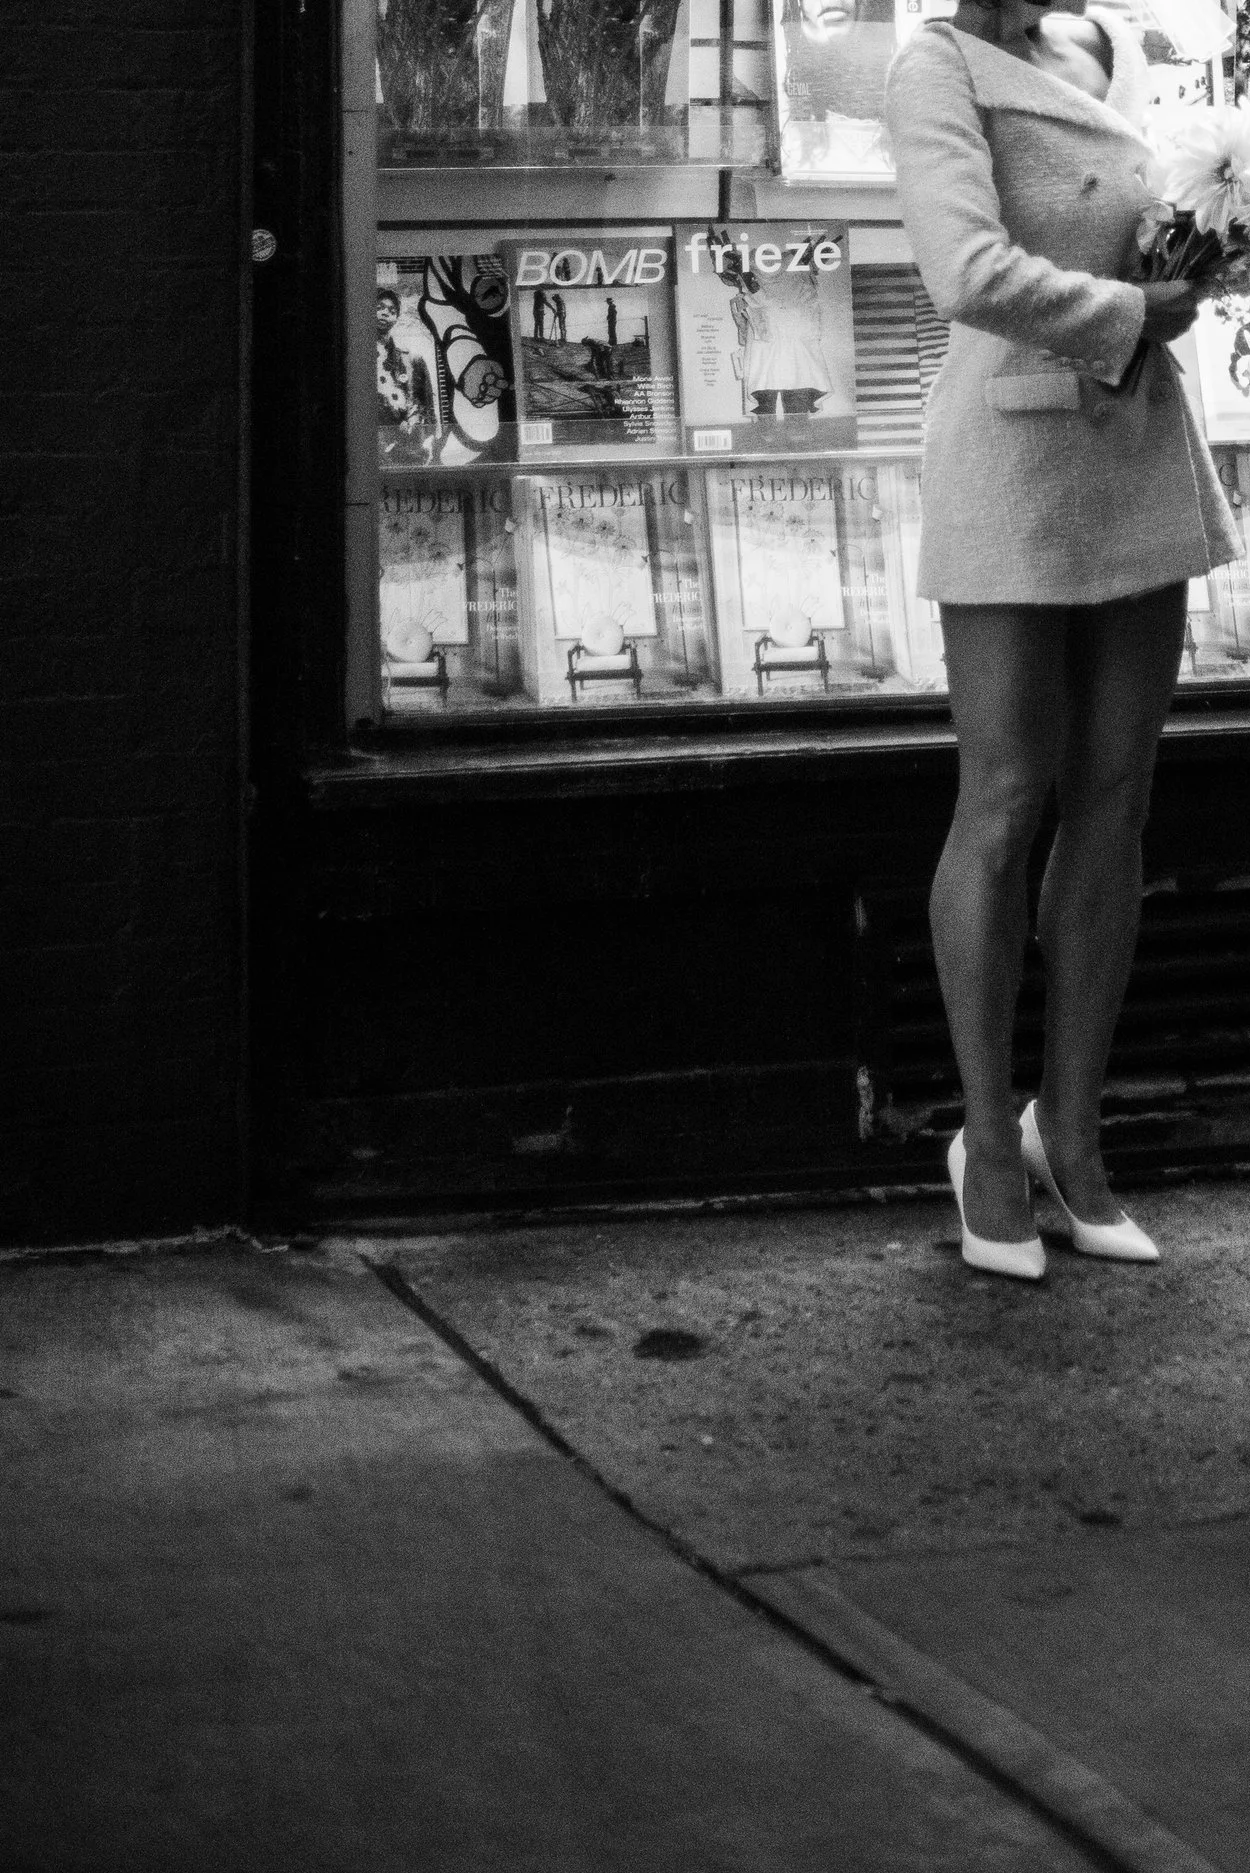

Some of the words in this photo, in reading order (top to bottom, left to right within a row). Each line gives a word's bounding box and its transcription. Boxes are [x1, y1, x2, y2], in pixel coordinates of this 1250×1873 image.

[515, 247, 668, 286] BOMB
[685, 232, 842, 274] frieze
[538, 480, 687, 511] FREDERIC
[730, 476, 877, 503] FREDERIC
